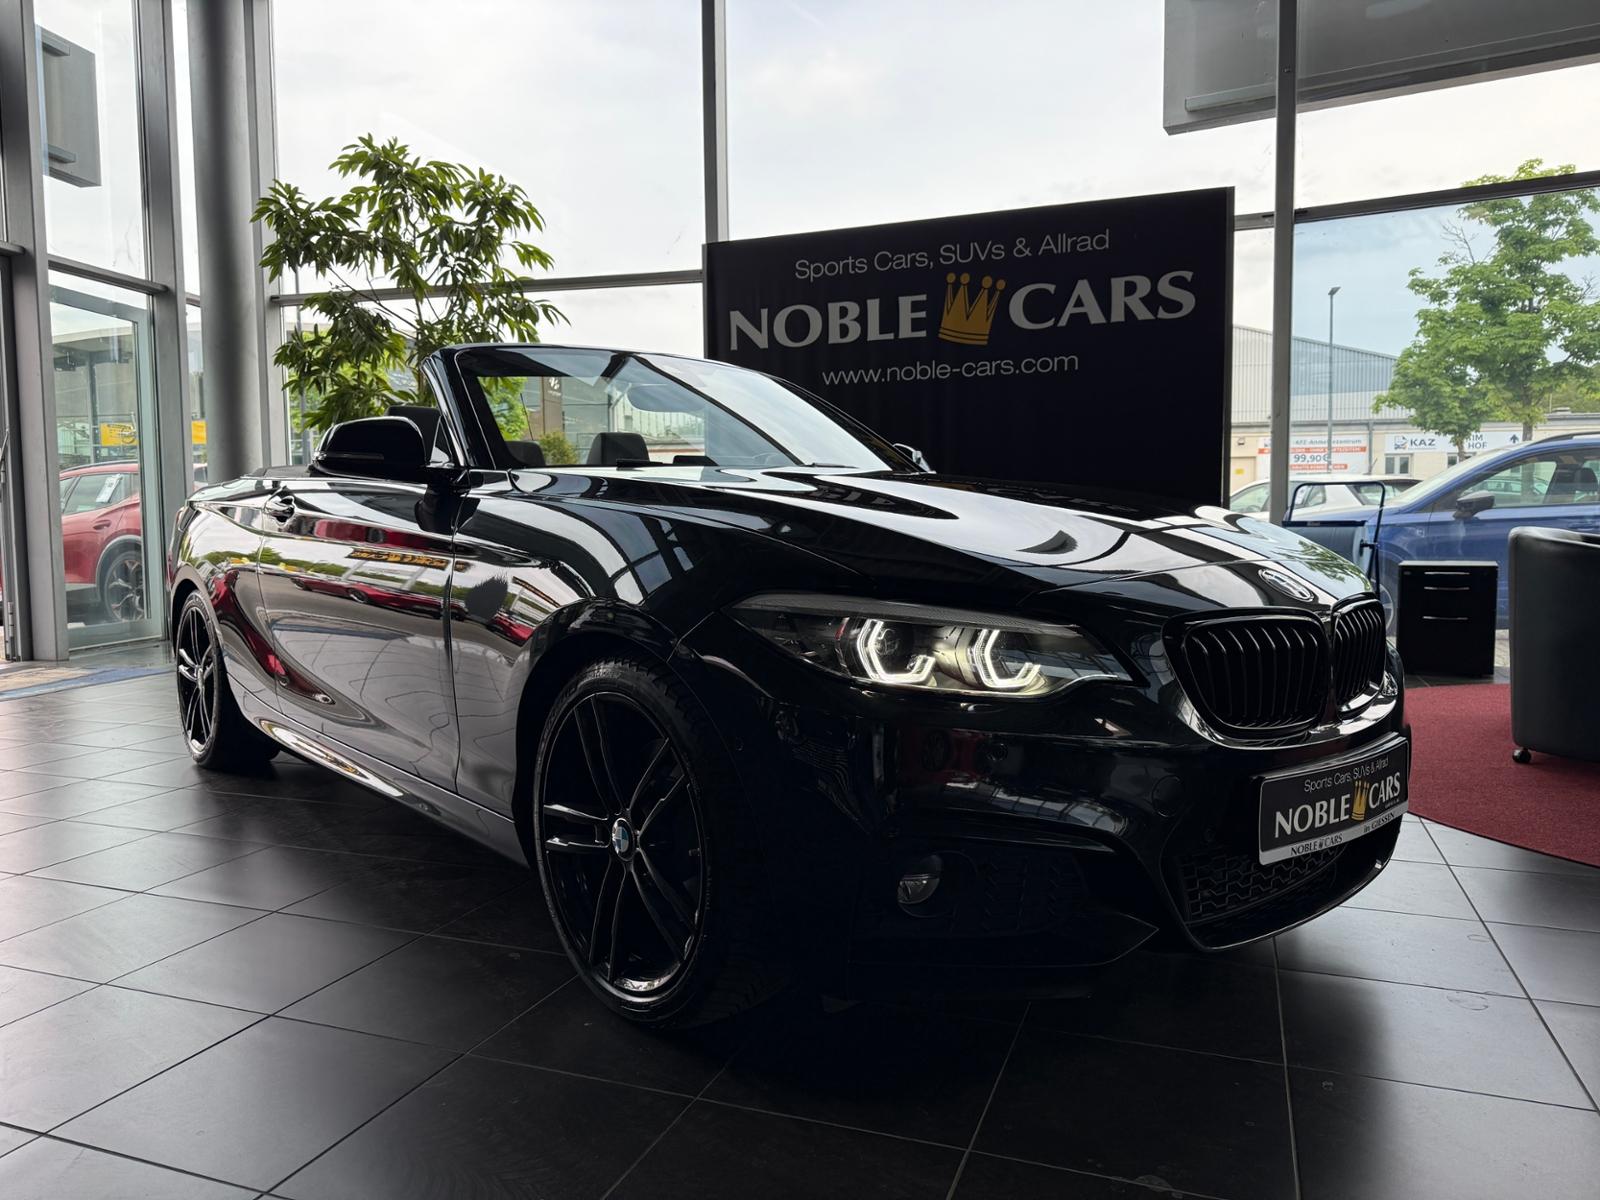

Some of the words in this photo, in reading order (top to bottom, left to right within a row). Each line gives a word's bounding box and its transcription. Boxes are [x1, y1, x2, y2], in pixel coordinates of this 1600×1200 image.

[795, 255, 868, 282] Sports
[874, 250, 934, 271] Cars,
[939, 240, 1005, 264] SUVs
[1013, 237, 1032, 257] &
[1038, 229, 1110, 255] Allrad
[729, 294, 927, 351] NOBLE
[1009, 270, 1196, 330] CARS
[822, 355, 1079, 385] www.noble-cars.com
[1410, 438, 1436, 447] KAZ
[1468, 441, 1488, 449] HOF
[1304, 776, 1333, 793] Sports
[1275, 794, 1350, 838] NOBLE
[1369, 772, 1400, 809] CARS
[1290, 840, 1318, 856] NOBLE
[1324, 833, 1343, 848] CARS
